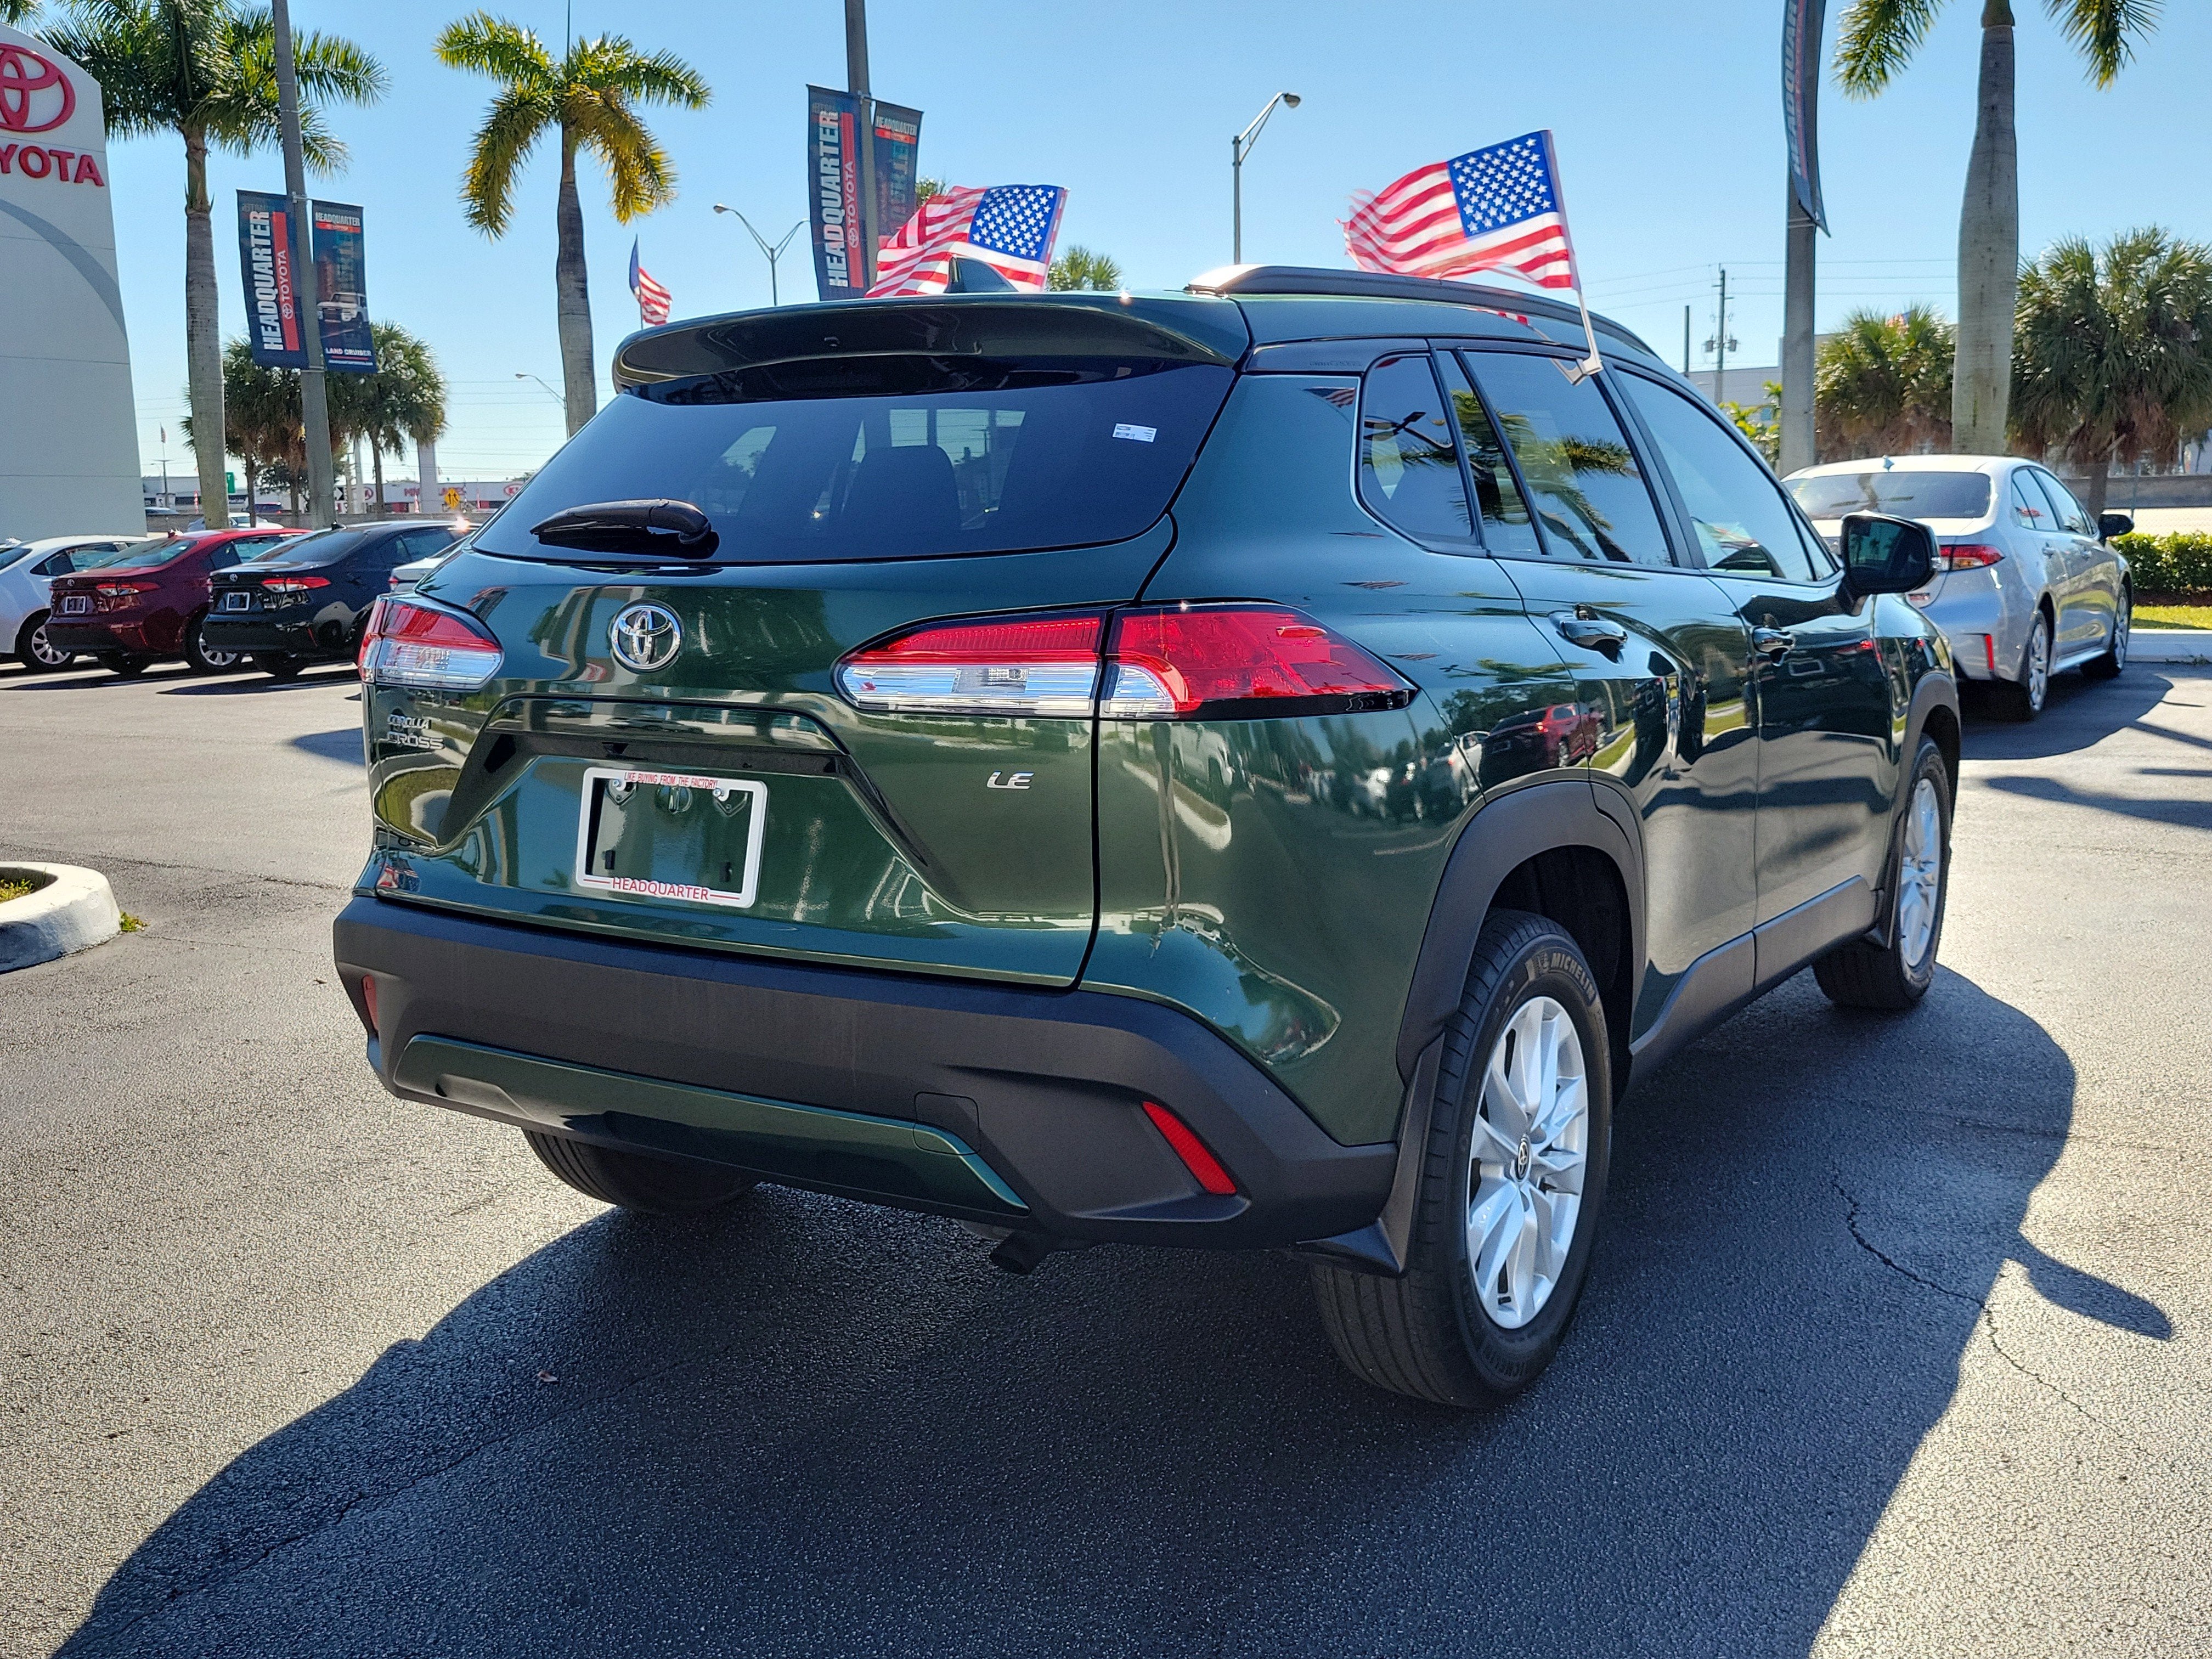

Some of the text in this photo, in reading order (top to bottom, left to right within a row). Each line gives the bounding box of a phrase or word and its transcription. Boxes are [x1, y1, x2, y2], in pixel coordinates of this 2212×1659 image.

[819, 110, 849, 288] HEADQUARTER
[843, 161, 856, 225] TOYOTA
[250, 211, 284, 351] HEADQUARTER
[275, 250, 290, 302] TOYOTA
[387, 714, 431, 730] COROLLA
[387, 731, 445, 749] CROSS
[624, 772, 718, 789] LIKE BUYING FROM THE FACTORY!
[986, 771, 1035, 789] LE
[612, 878, 708, 900] HEADQUARTER
[1551, 952, 1596, 1002] MICHELIN
